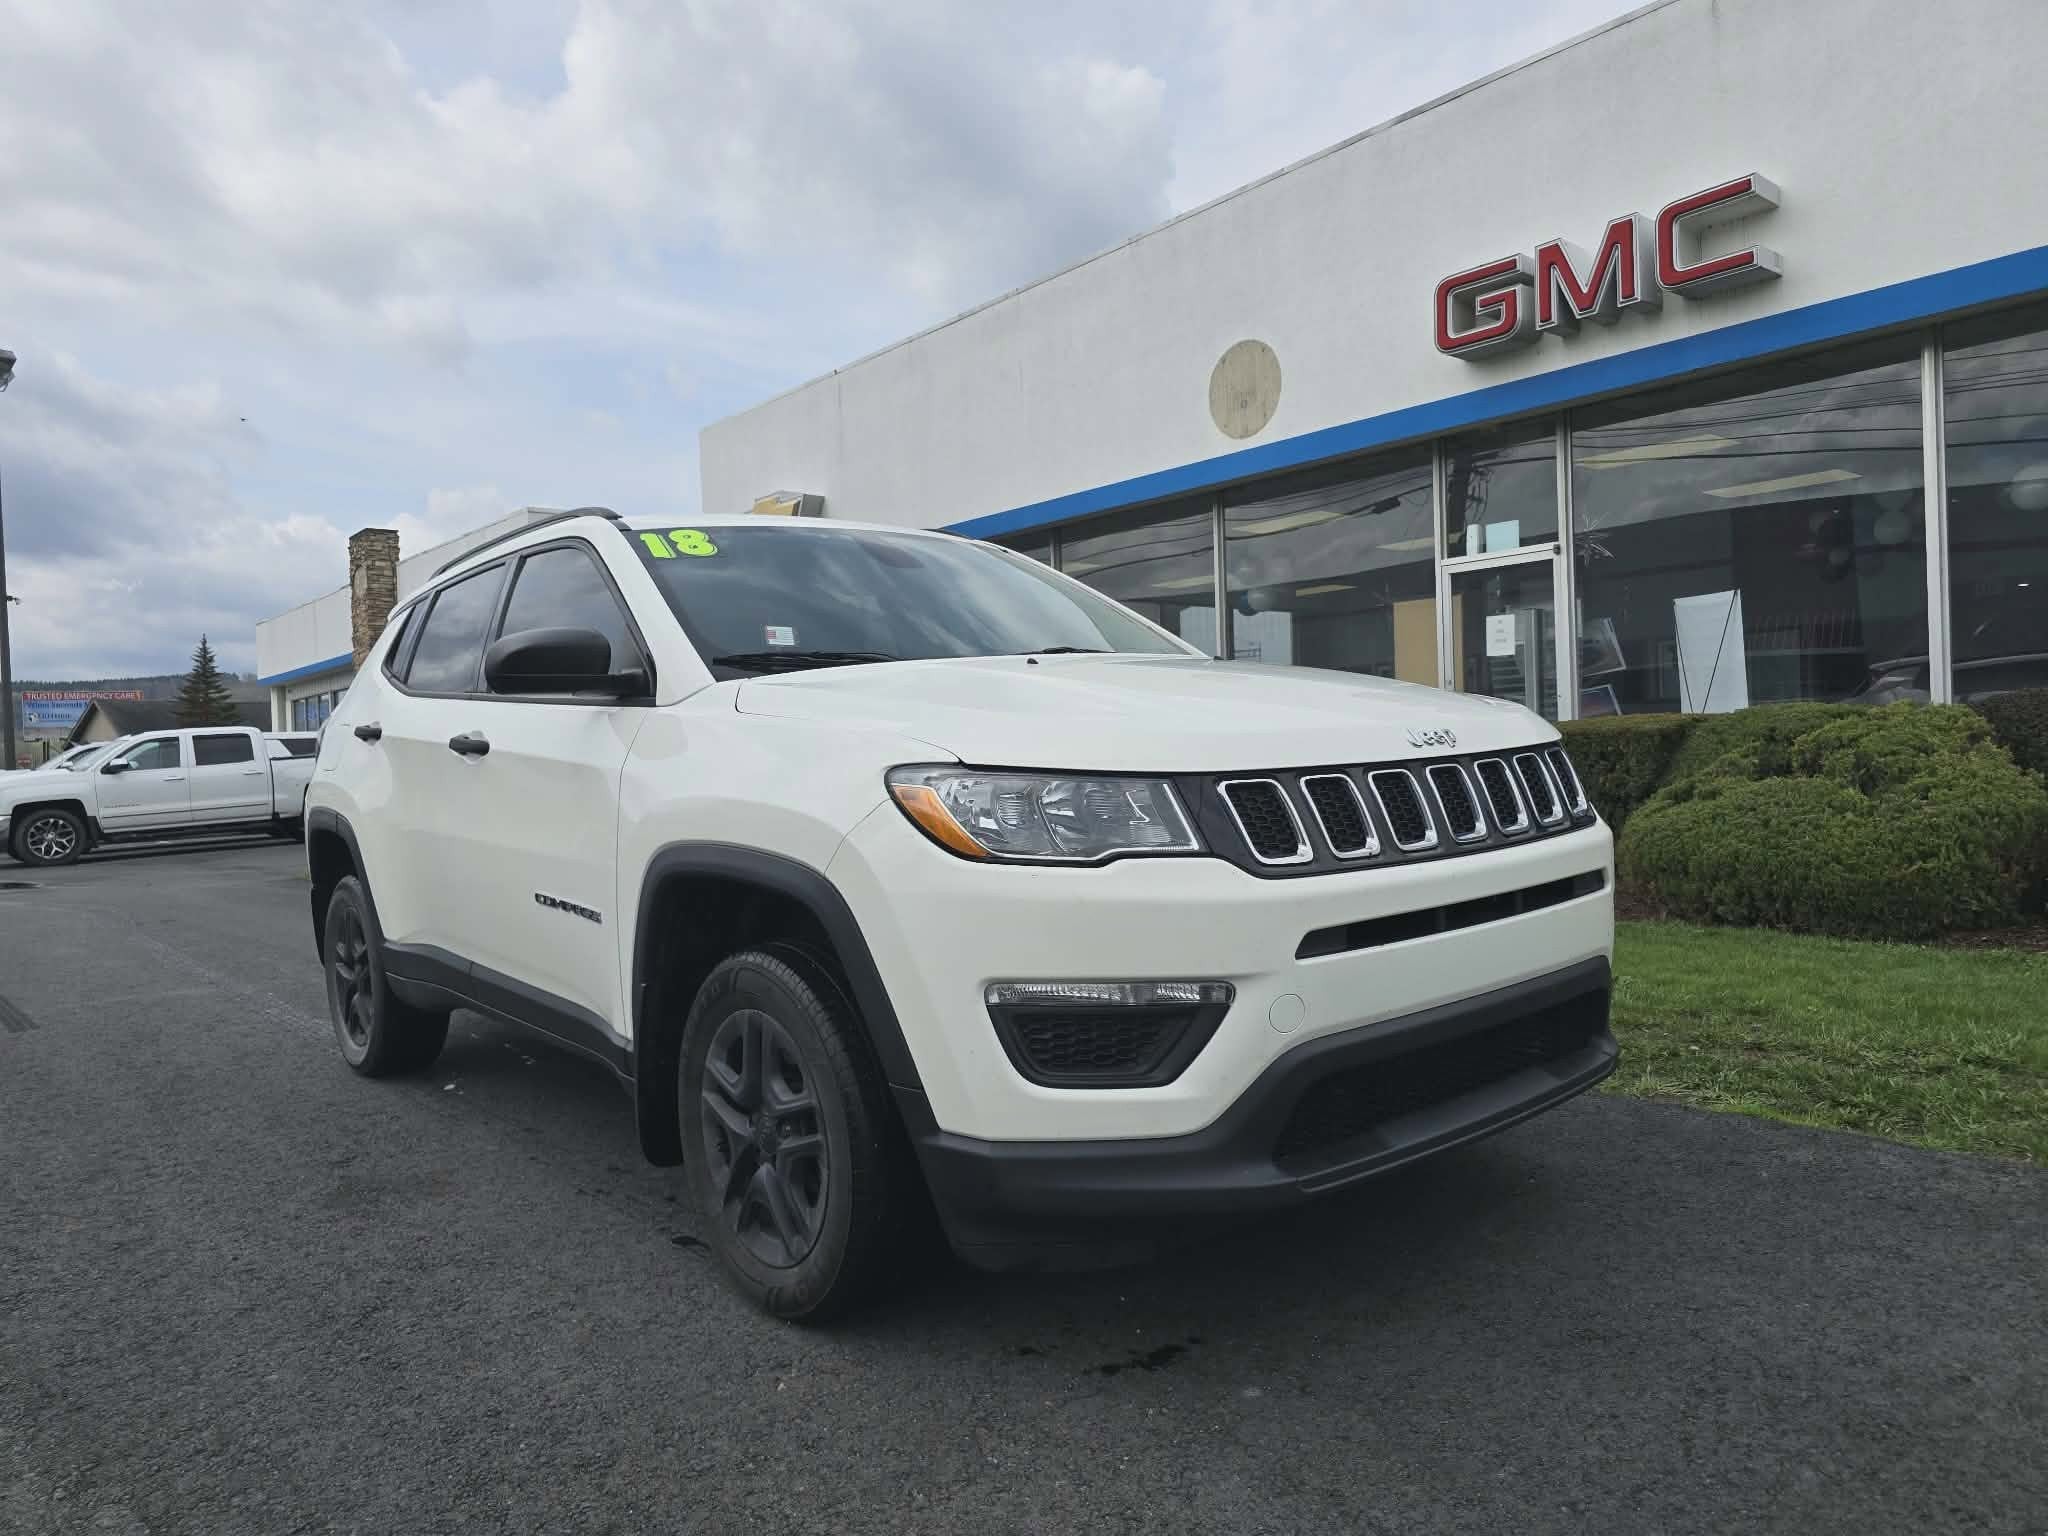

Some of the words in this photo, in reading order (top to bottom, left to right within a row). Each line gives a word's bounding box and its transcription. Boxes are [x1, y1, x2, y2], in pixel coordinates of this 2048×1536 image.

[1434, 172, 1768, 356] GMC
[639, 529, 719, 559] 18
[1408, 728, 1457, 748] Jeep
[534, 892, 602, 925] COMPASS
